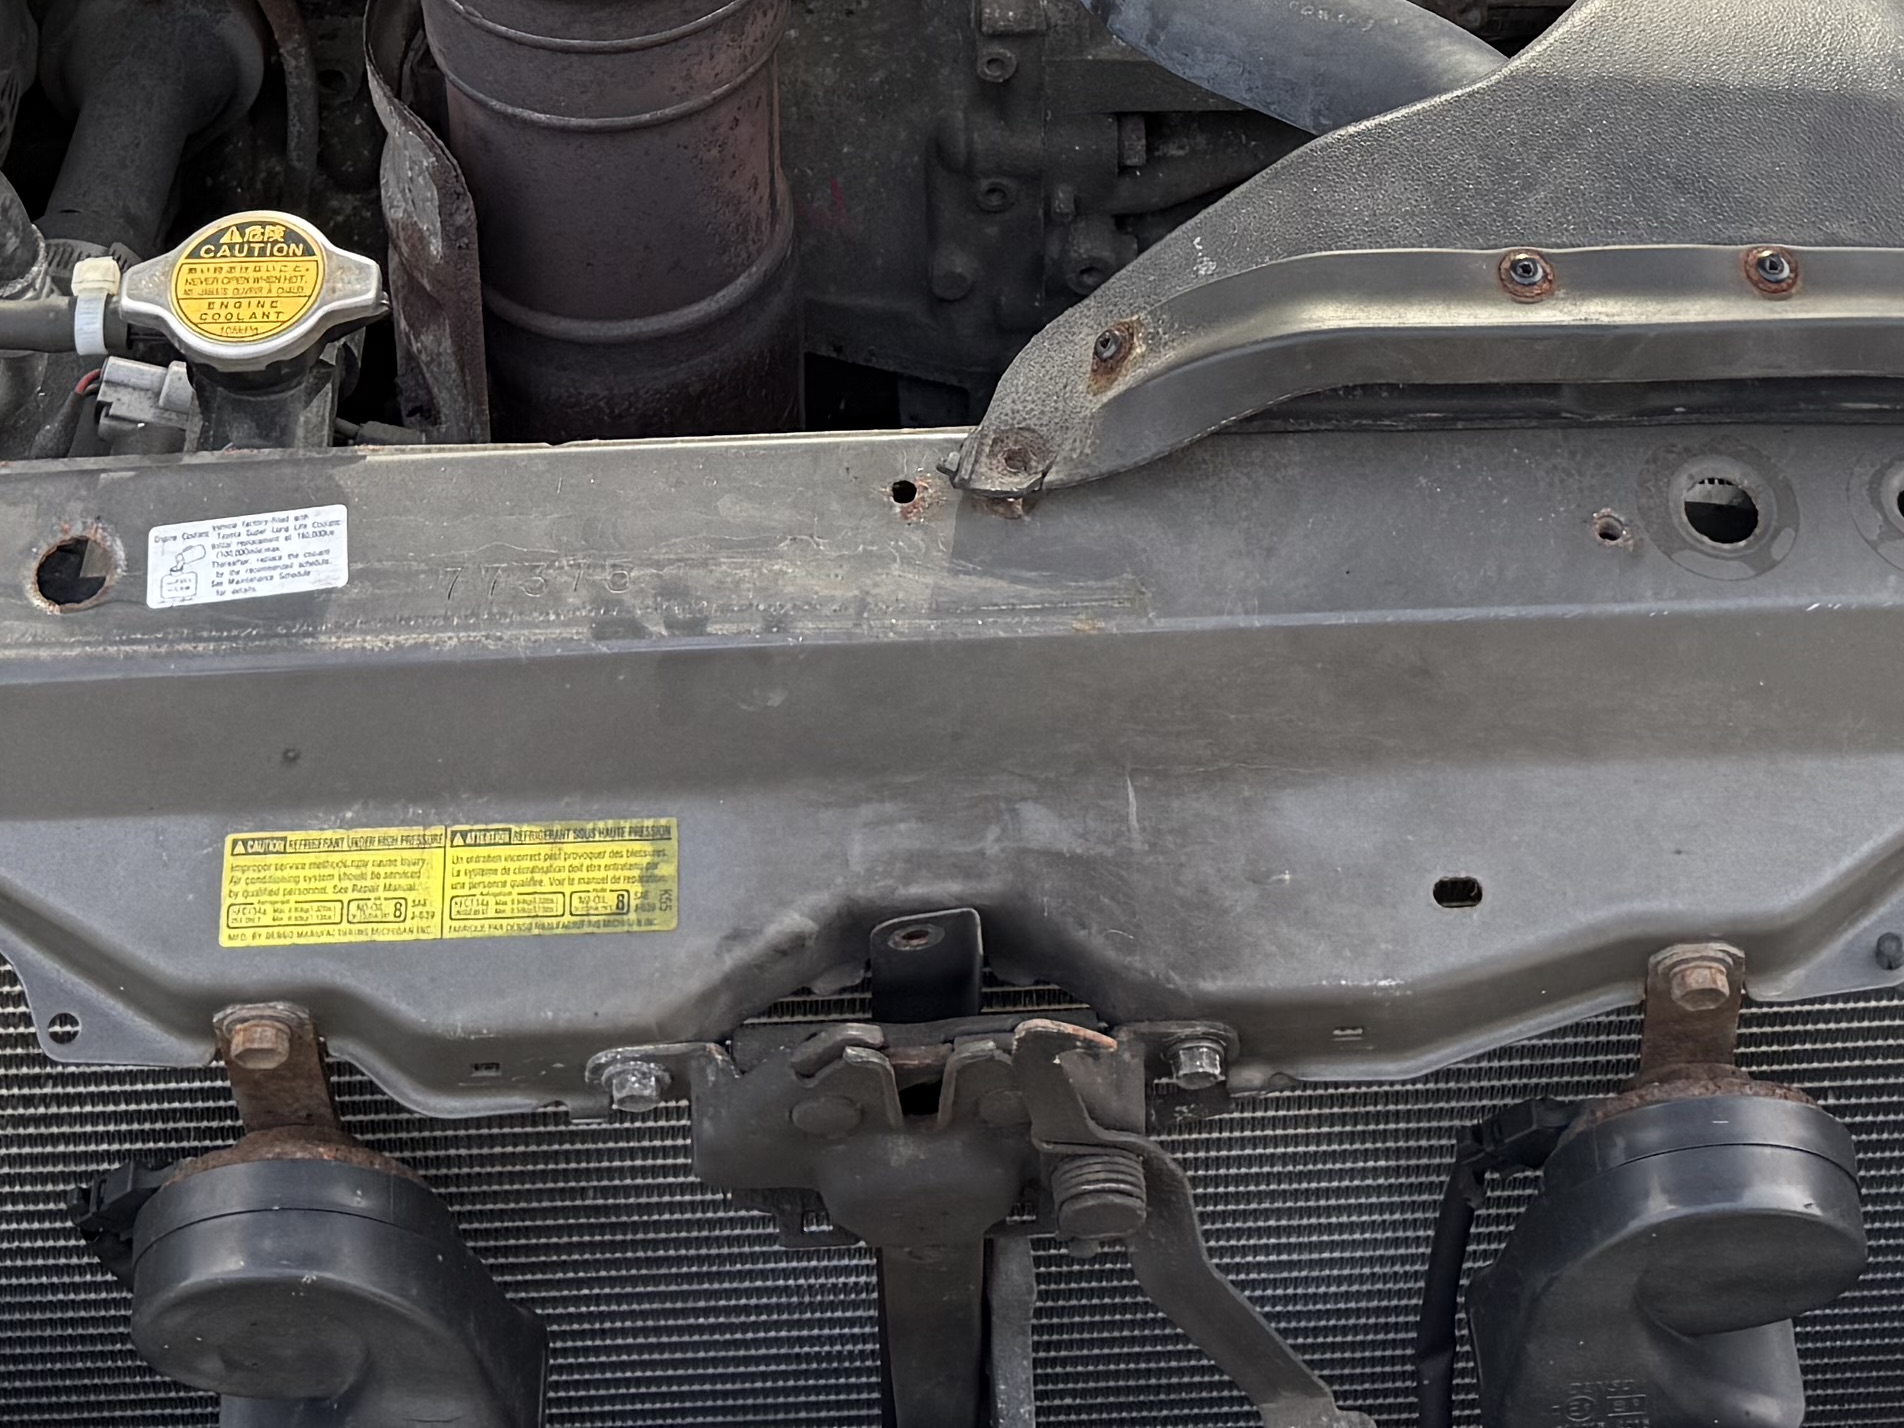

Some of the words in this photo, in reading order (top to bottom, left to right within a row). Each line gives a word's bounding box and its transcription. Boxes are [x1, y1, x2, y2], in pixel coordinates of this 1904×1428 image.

[244, 225, 286, 242] 危険
[200, 243, 304, 258] CAUTION
[185, 277, 218, 286] NEVER
[222, 276, 249, 285] OPEN
[253, 275, 281, 284] WHEN
[207, 300, 279, 310] ENGINE
[200, 311, 284, 321] COOLANT
[598, 828, 626, 840] HAUTE
[628, 825, 671, 839] PRESSION
[247, 839, 286, 853] CAUTION
[400, 833, 443, 848] PRESSURE
[609, 848, 624, 859] des
[230, 862, 272, 874] Improper
[468, 878, 507, 891] personne
[548, 874, 565, 886] Voir
[577, 874, 608, 885] manuel
[610, 873, 621, 884] de
[228, 888, 239, 899] by
[242, 886, 280, 899] qualified
[351, 883, 380, 896] Repair
[615, 893, 625, 911] 8
[393, 901, 402, 919] 8
